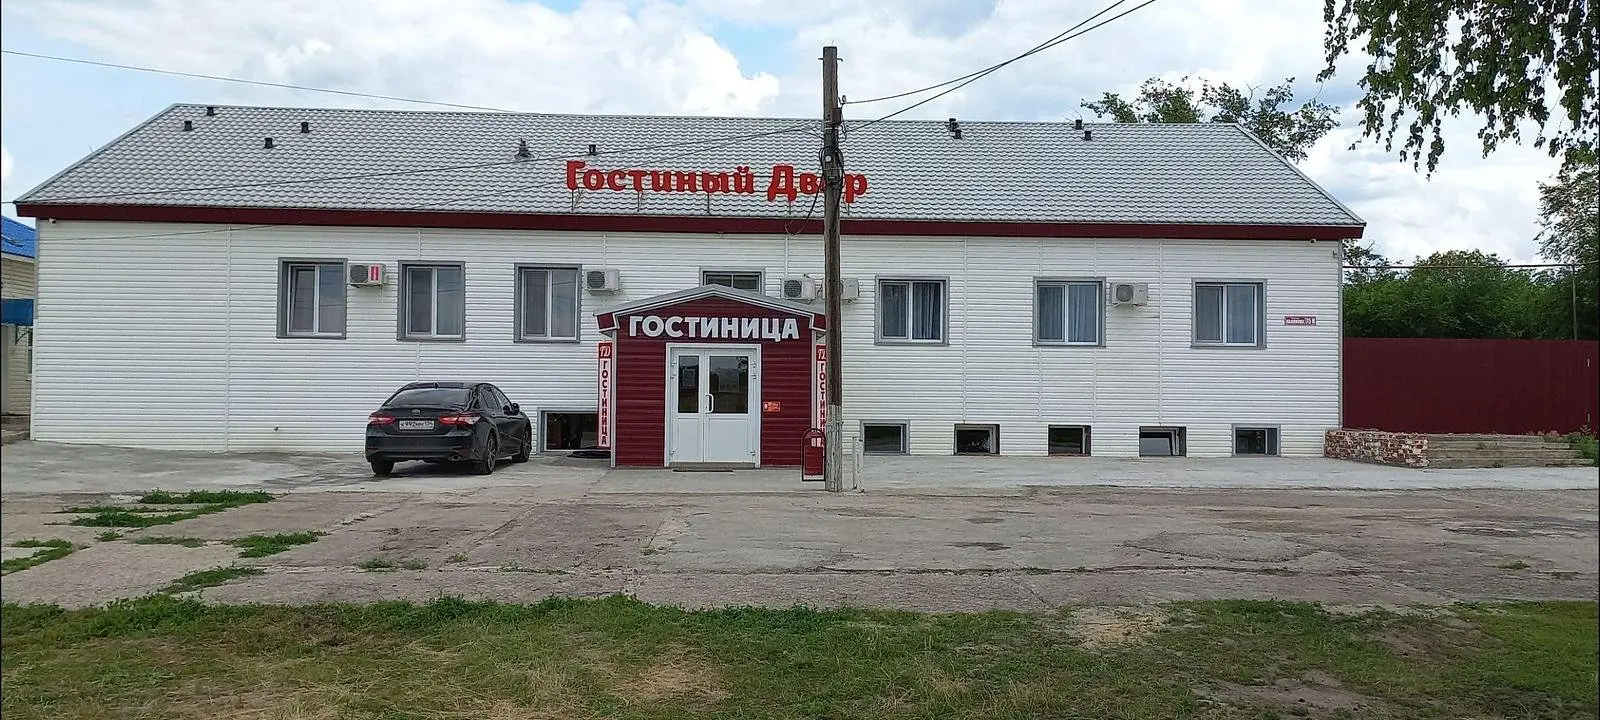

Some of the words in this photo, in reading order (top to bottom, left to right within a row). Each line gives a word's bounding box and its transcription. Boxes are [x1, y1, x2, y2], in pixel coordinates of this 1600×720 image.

[566, 160, 755, 194] Гостиный
[767, 164, 868, 204] Двр
[629, 315, 800, 342] ГОСТИНИЦА
